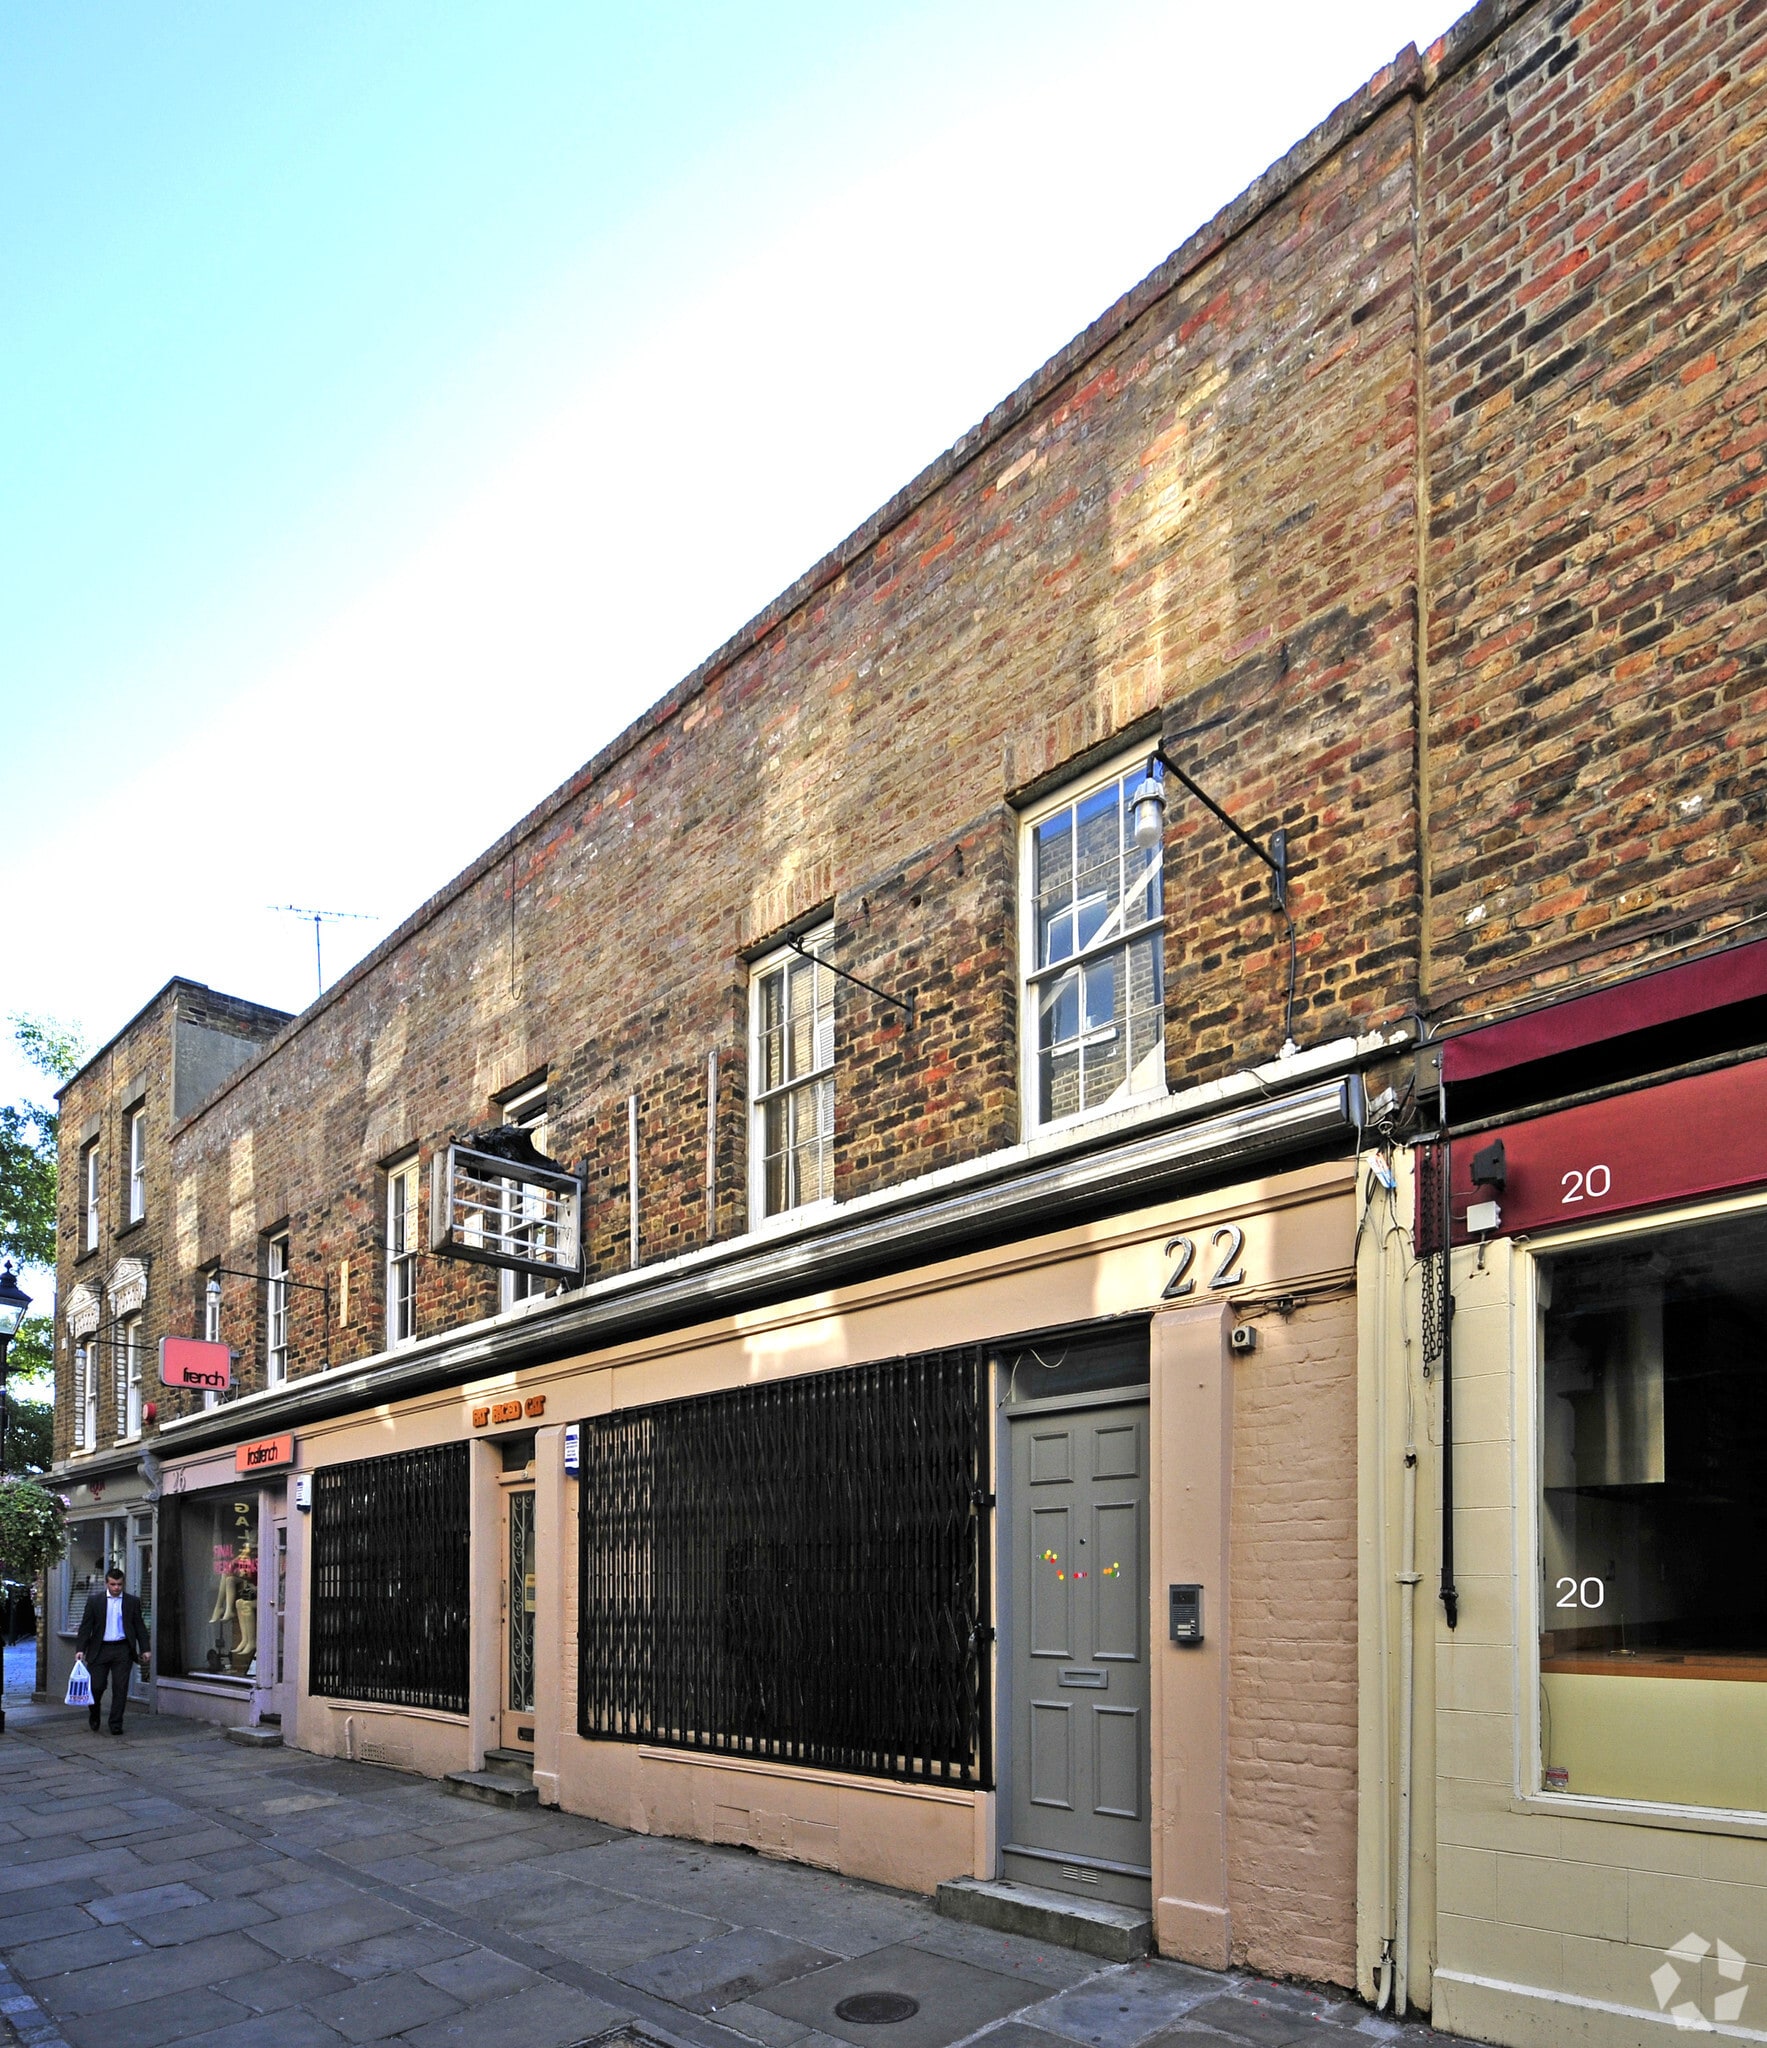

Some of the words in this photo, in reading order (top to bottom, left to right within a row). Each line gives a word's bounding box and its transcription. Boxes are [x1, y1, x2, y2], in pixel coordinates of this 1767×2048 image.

[1561, 1164, 1611, 1204] 20
[1160, 1224, 1244, 1300] 22
[183, 1366, 226, 1387] french
[473, 1407, 490, 1428] FAT
[492, 1400, 522, 1424] FACED
[525, 1395, 546, 1418] CAT
[172, 1466, 187, 1493] 26
[1555, 1576, 1605, 1609] 20
